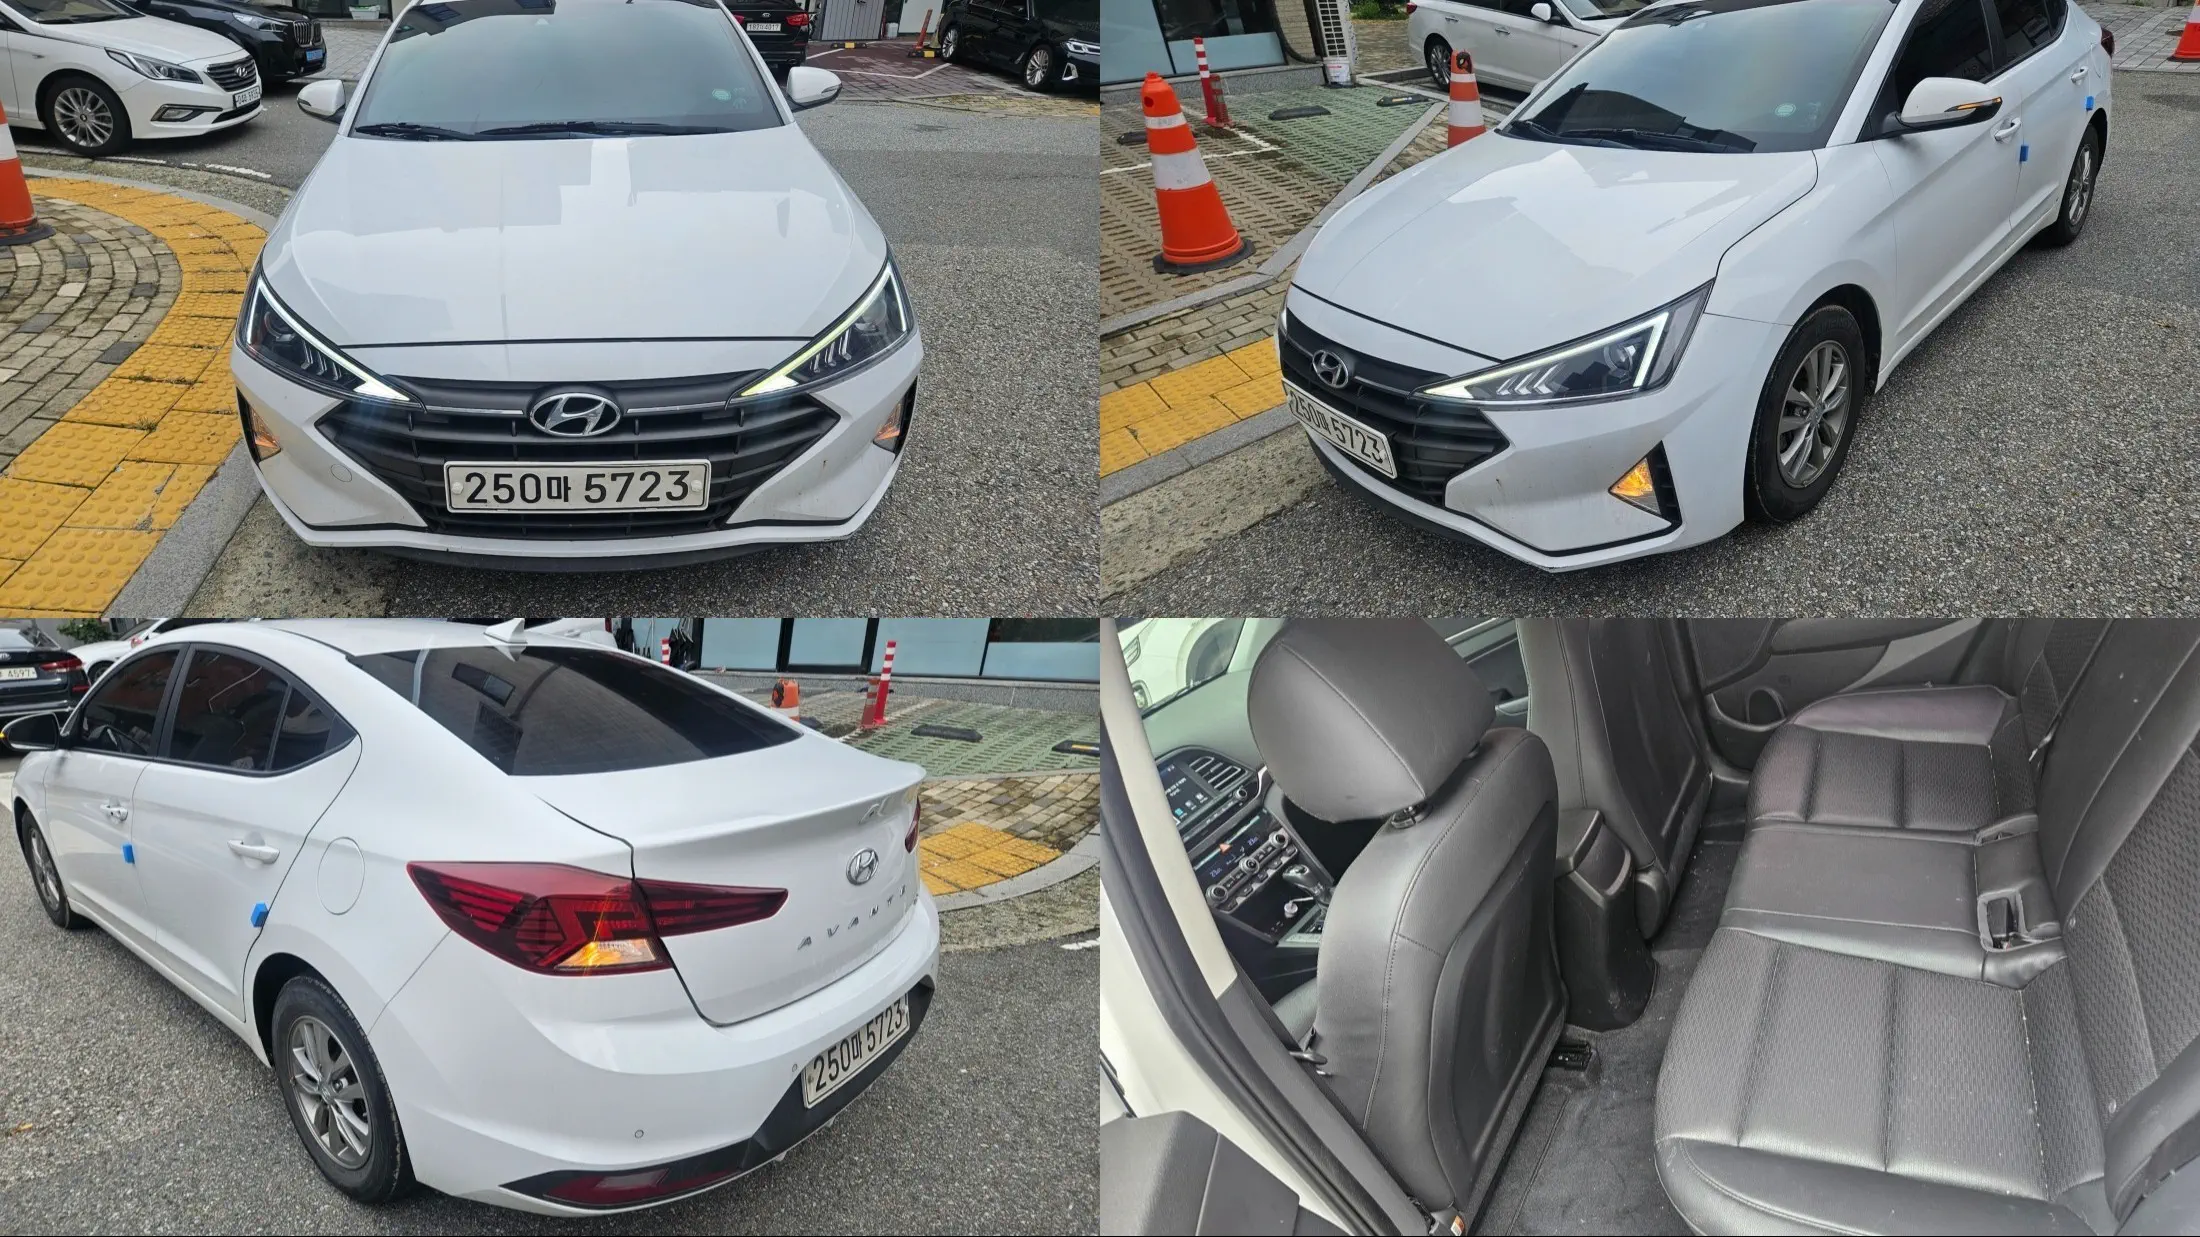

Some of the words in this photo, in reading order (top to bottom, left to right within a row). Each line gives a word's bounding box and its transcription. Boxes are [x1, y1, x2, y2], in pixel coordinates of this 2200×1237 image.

[1290, 391, 1331, 434] 250마
[1331, 416, 1383, 464] 5723
[465, 472, 571, 504] 250마
[584, 470, 691, 504] 5723
[813, 1032, 862, 1092] 250마
[866, 1000, 902, 1052] 5723
